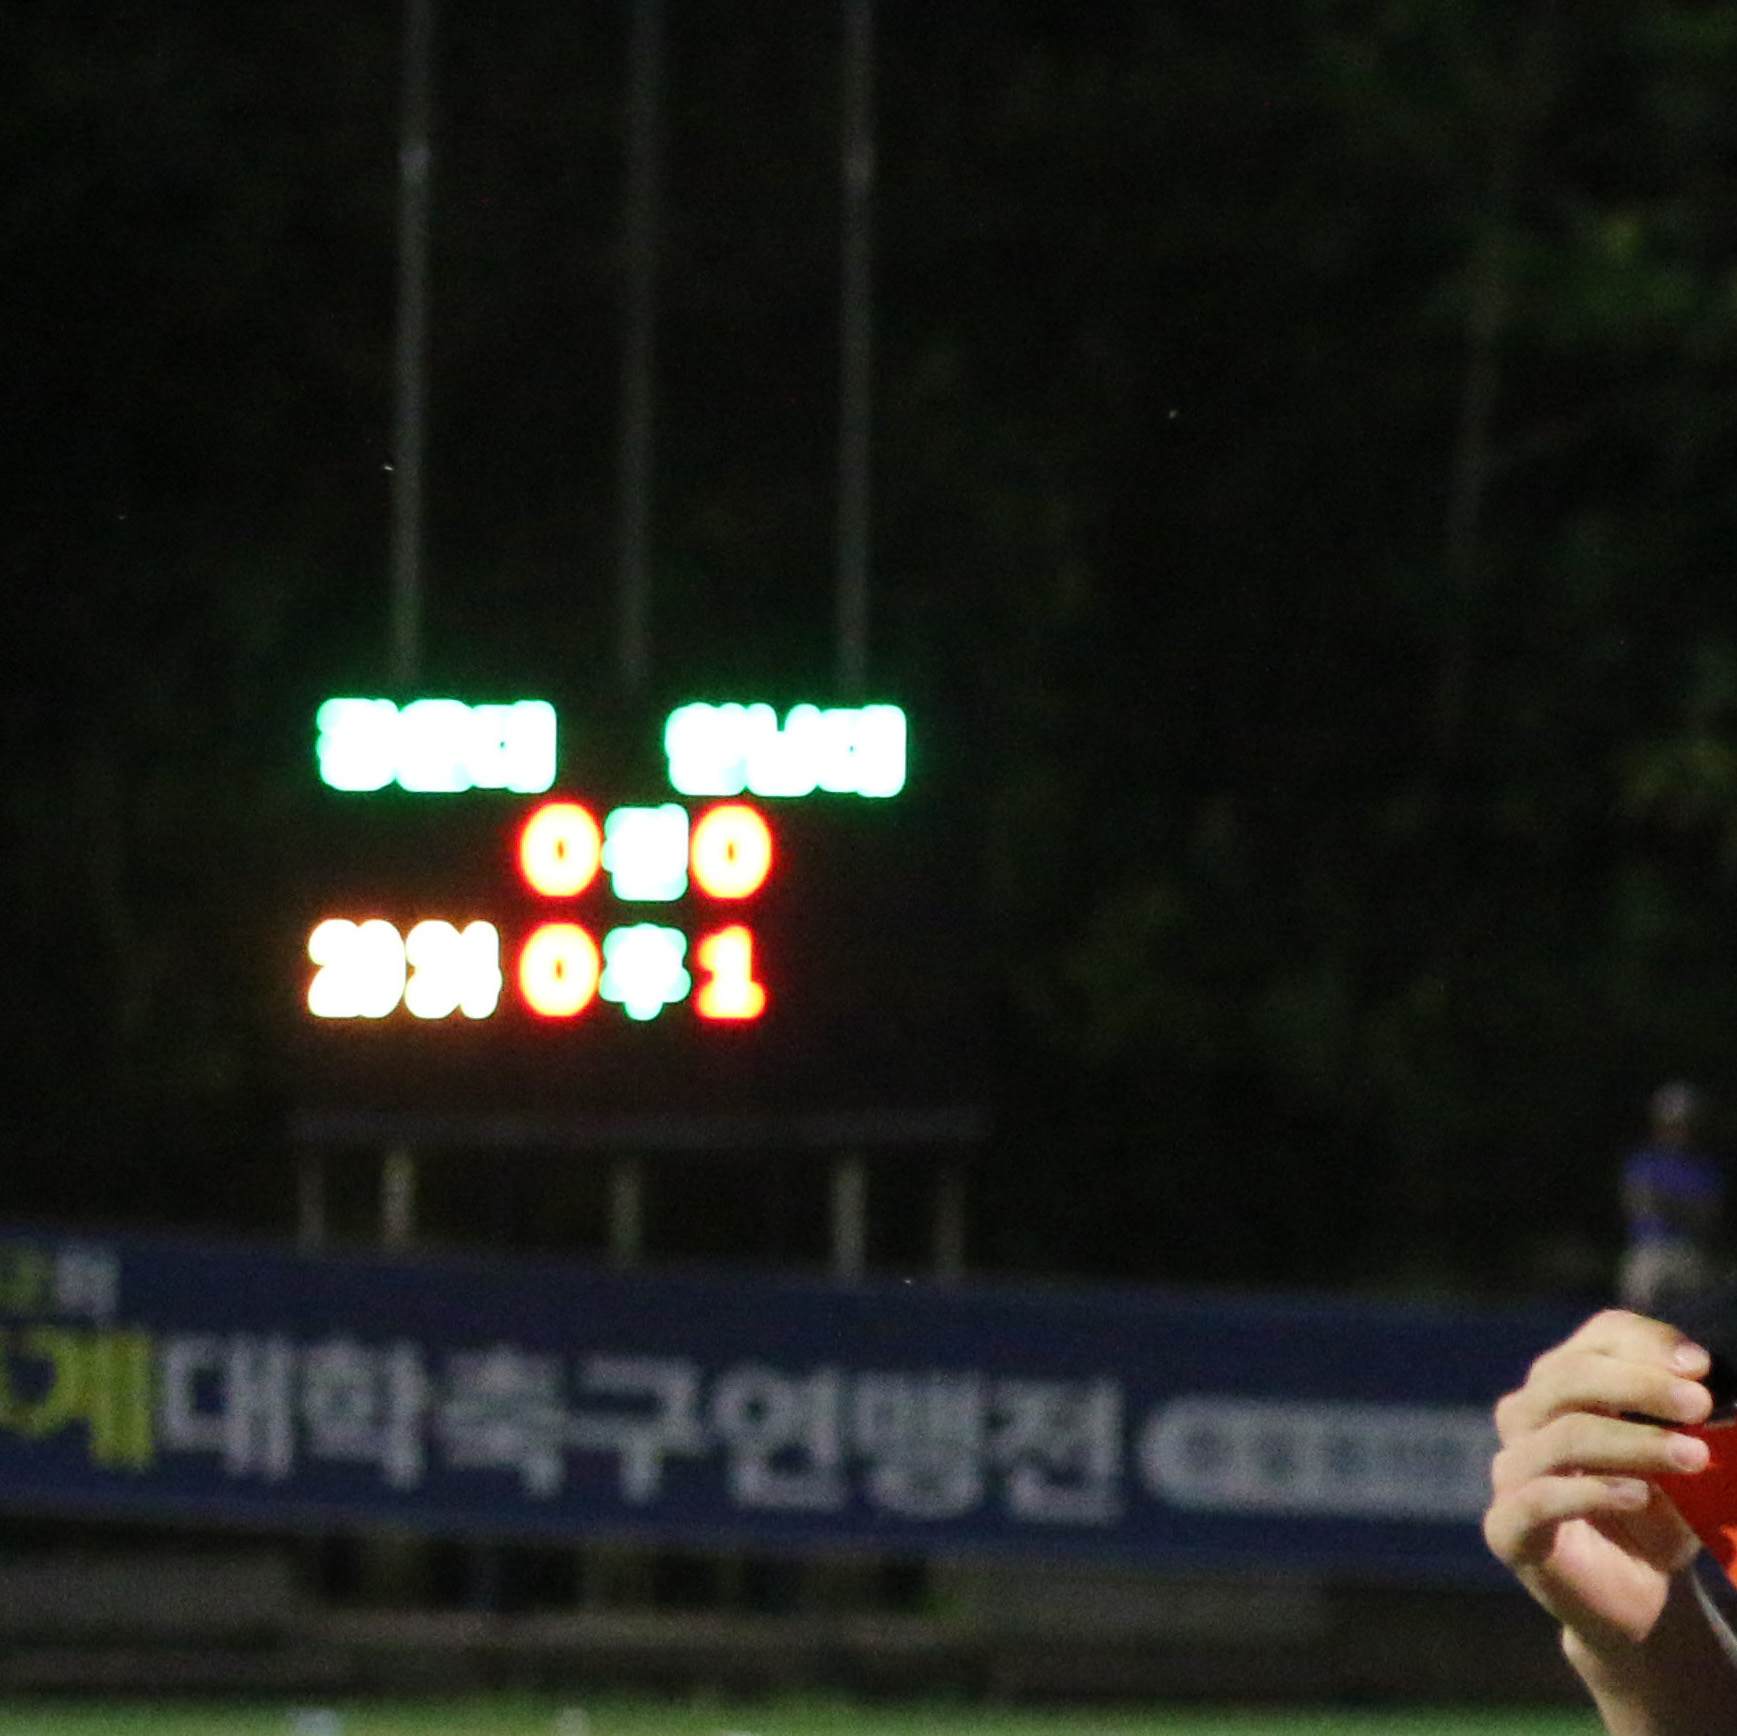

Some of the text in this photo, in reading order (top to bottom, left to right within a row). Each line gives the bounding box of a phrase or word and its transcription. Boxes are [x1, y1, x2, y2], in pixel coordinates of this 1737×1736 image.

[519, 802, 601, 898] 0
[691, 803, 772, 899] 0
[518, 921, 601, 1018] 0
[696, 923, 767, 1020] 1
